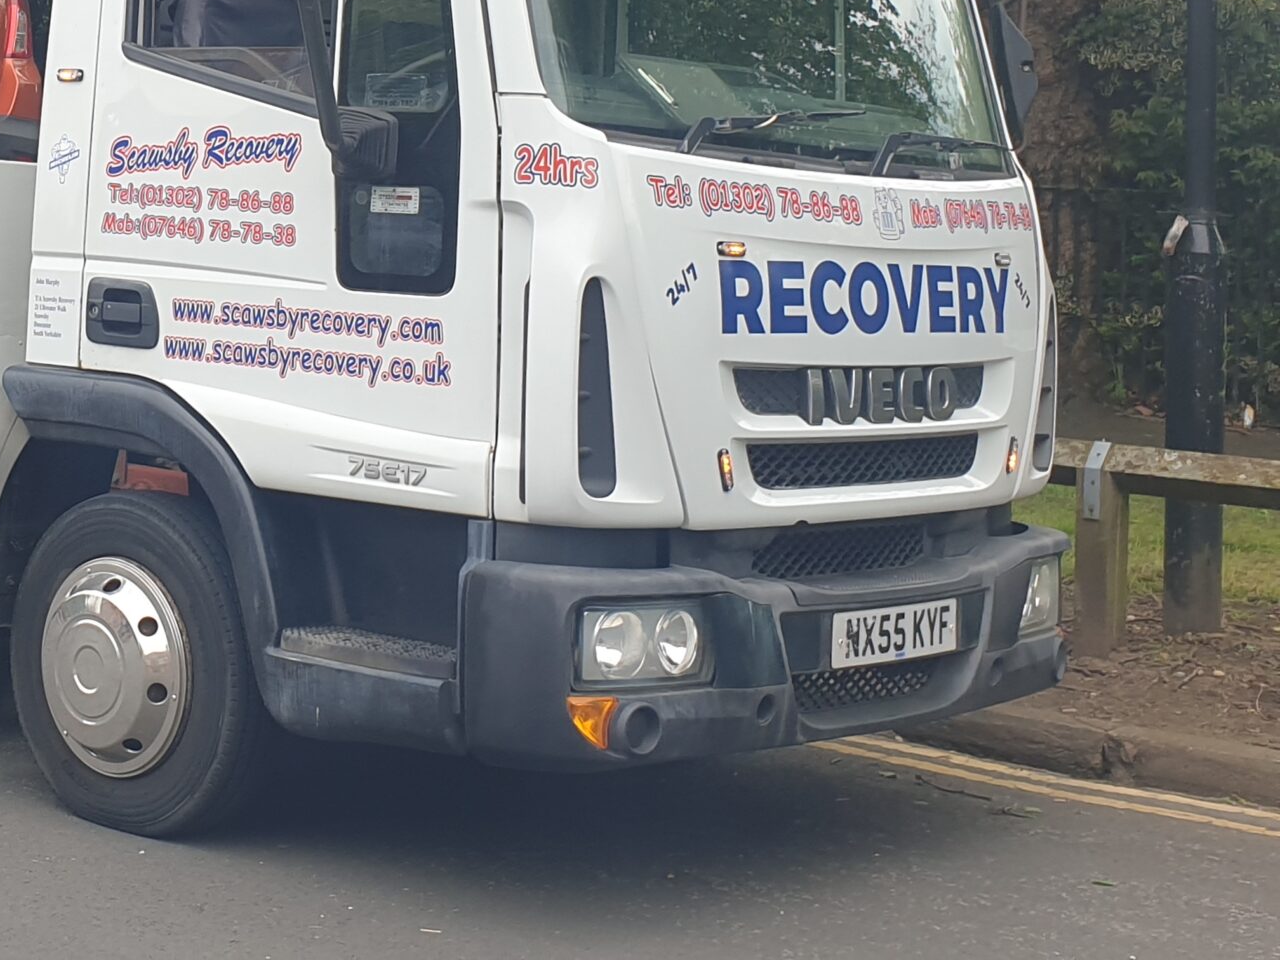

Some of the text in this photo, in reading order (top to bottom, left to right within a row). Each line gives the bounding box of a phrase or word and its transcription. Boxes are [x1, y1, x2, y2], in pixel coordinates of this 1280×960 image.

[106, 127, 198, 179] Scawsby
[203, 126, 301, 172] Recovery
[514, 143, 599, 188] 24hrs
[207, 189, 294, 214] 78-86-88
[647, 175, 862, 225] Tel: (01302) 78-86-88
[910, 199, 942, 228] Mob:
[209, 220, 296, 246] 78-78-38
[666, 262, 698, 306] 24/7
[719, 259, 1008, 335] RECOVERY
[173, 298, 443, 347] www.scawsbyrecovery.com
[164, 334, 452, 387] www.scawsbyrecovery.co.uk
[807, 366, 956, 426] IVECO
[348, 456, 428, 487] 75E17
[845, 605, 950, 659] NX55 KYF
